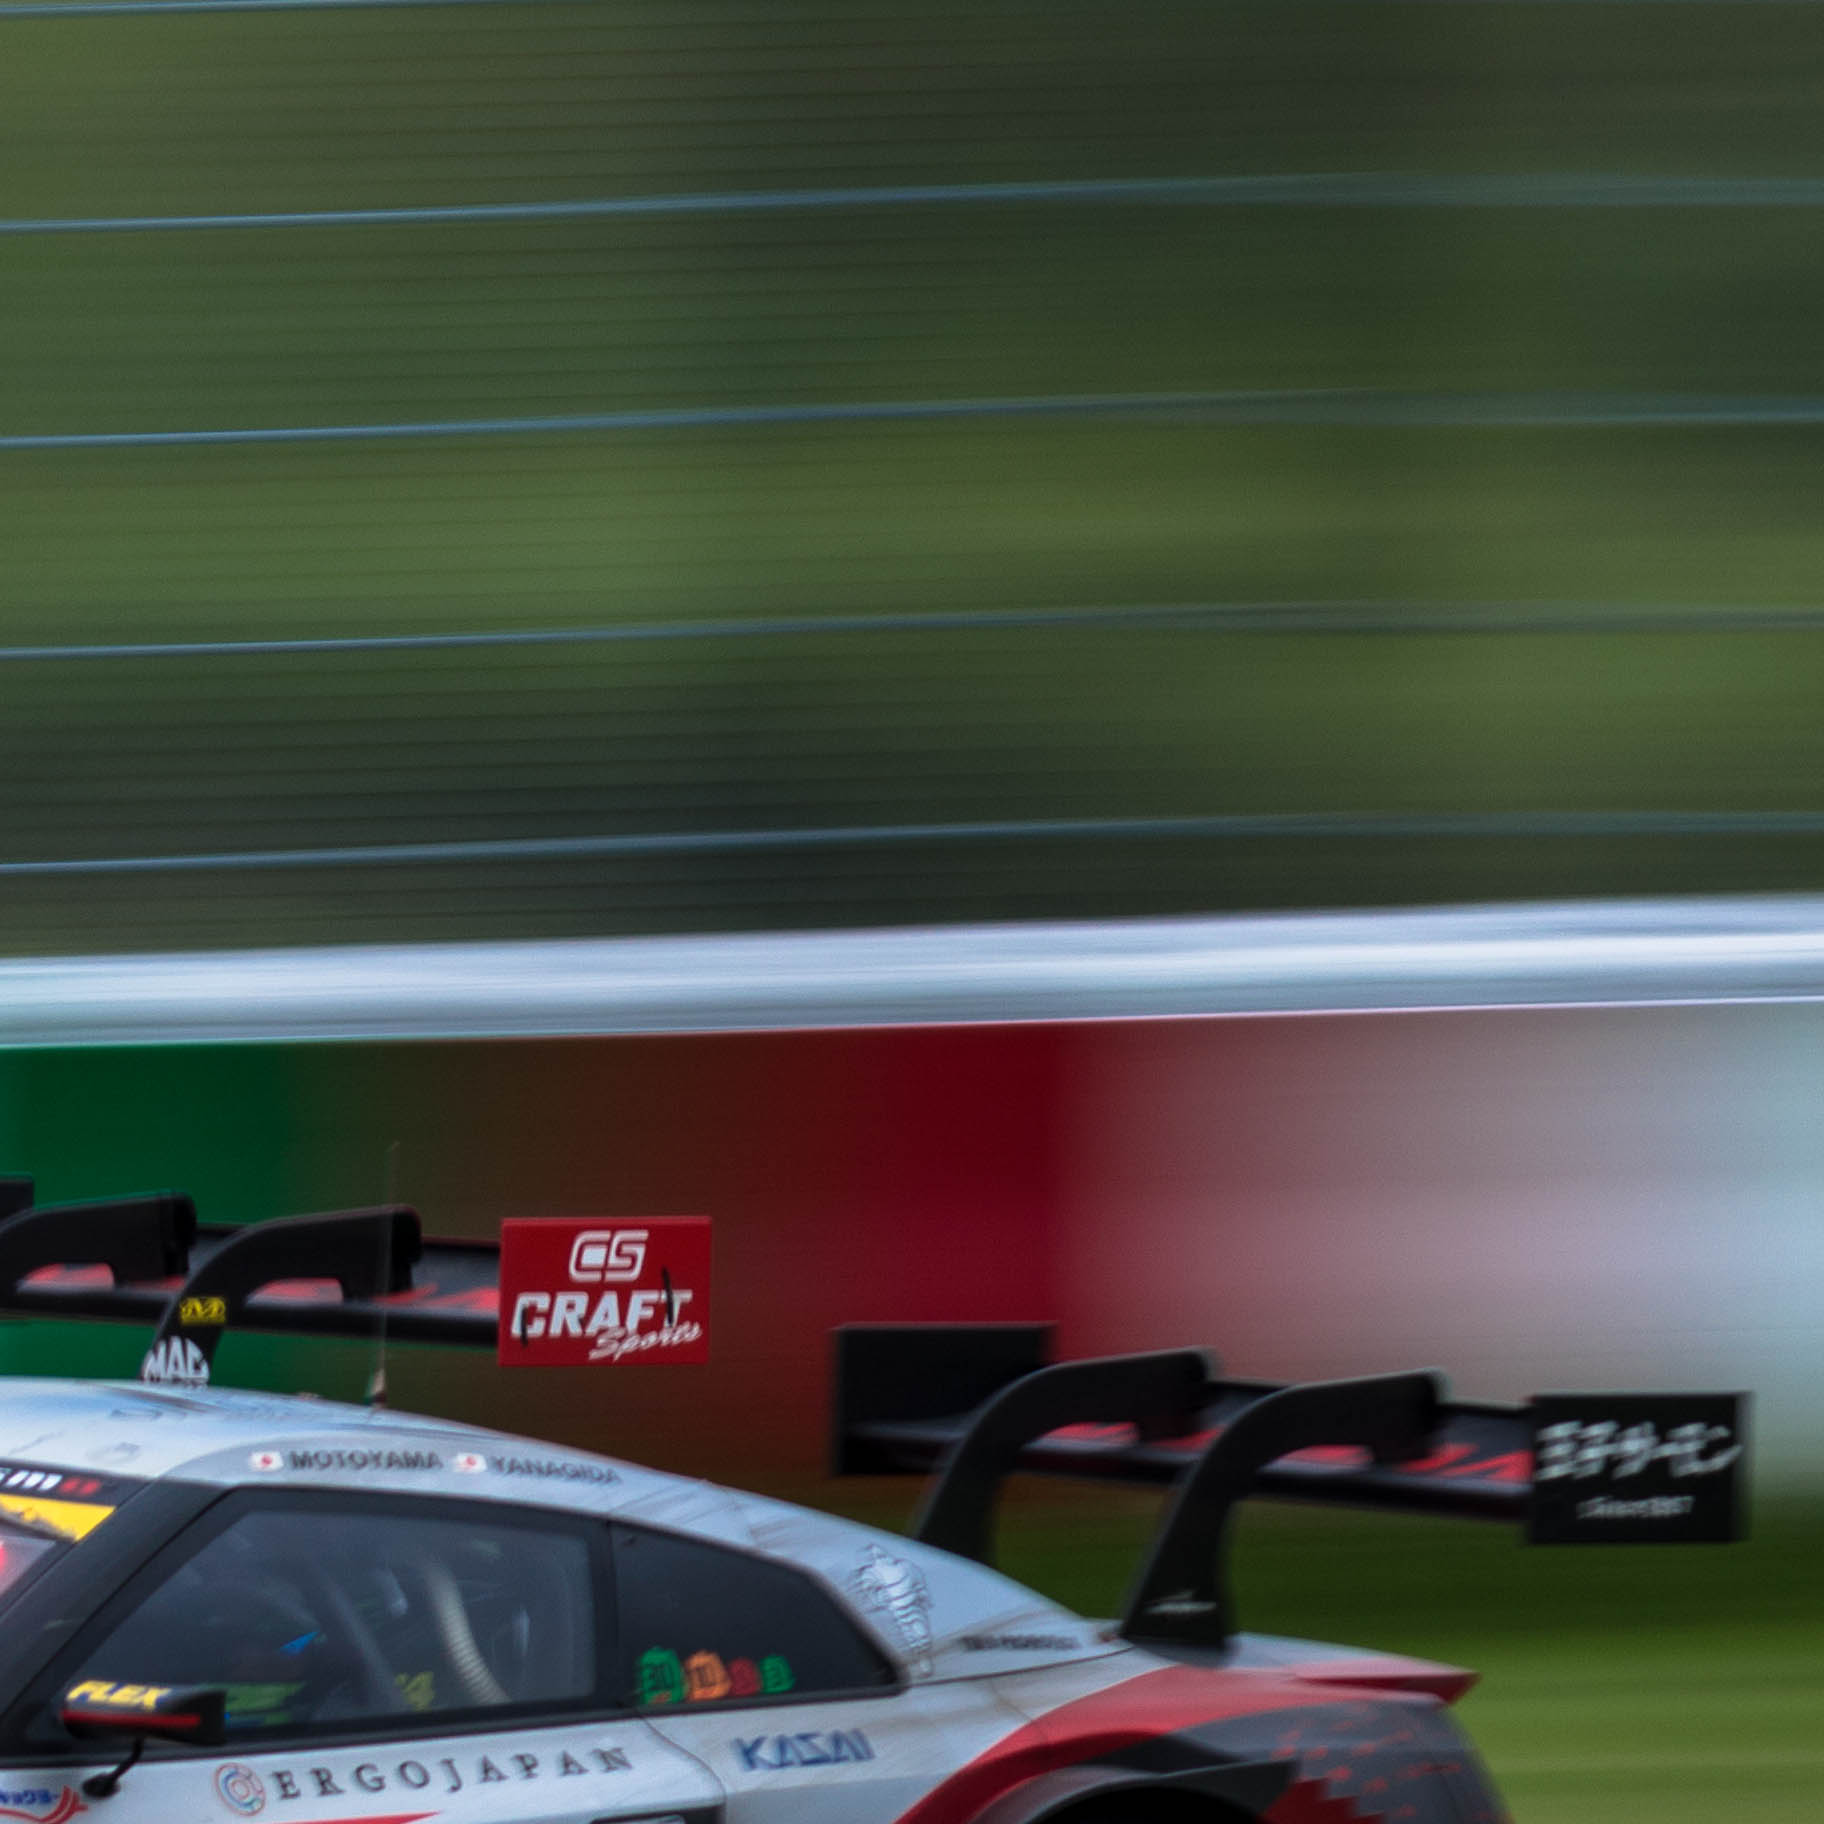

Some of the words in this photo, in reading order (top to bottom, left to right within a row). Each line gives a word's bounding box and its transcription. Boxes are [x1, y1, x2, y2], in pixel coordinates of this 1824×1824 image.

[568, 1229, 650, 1283] CS
[510, 1290, 693, 1338] CRAFT
[588, 1322, 705, 1362] Sports
[288, 1449, 444, 1473] MOTOYAMA
[487, 1455, 622, 1486] YANAGIDA
[67, 1680, 172, 1709] FLEX
[272, 1746, 634, 1802] ERGOJAPAN
